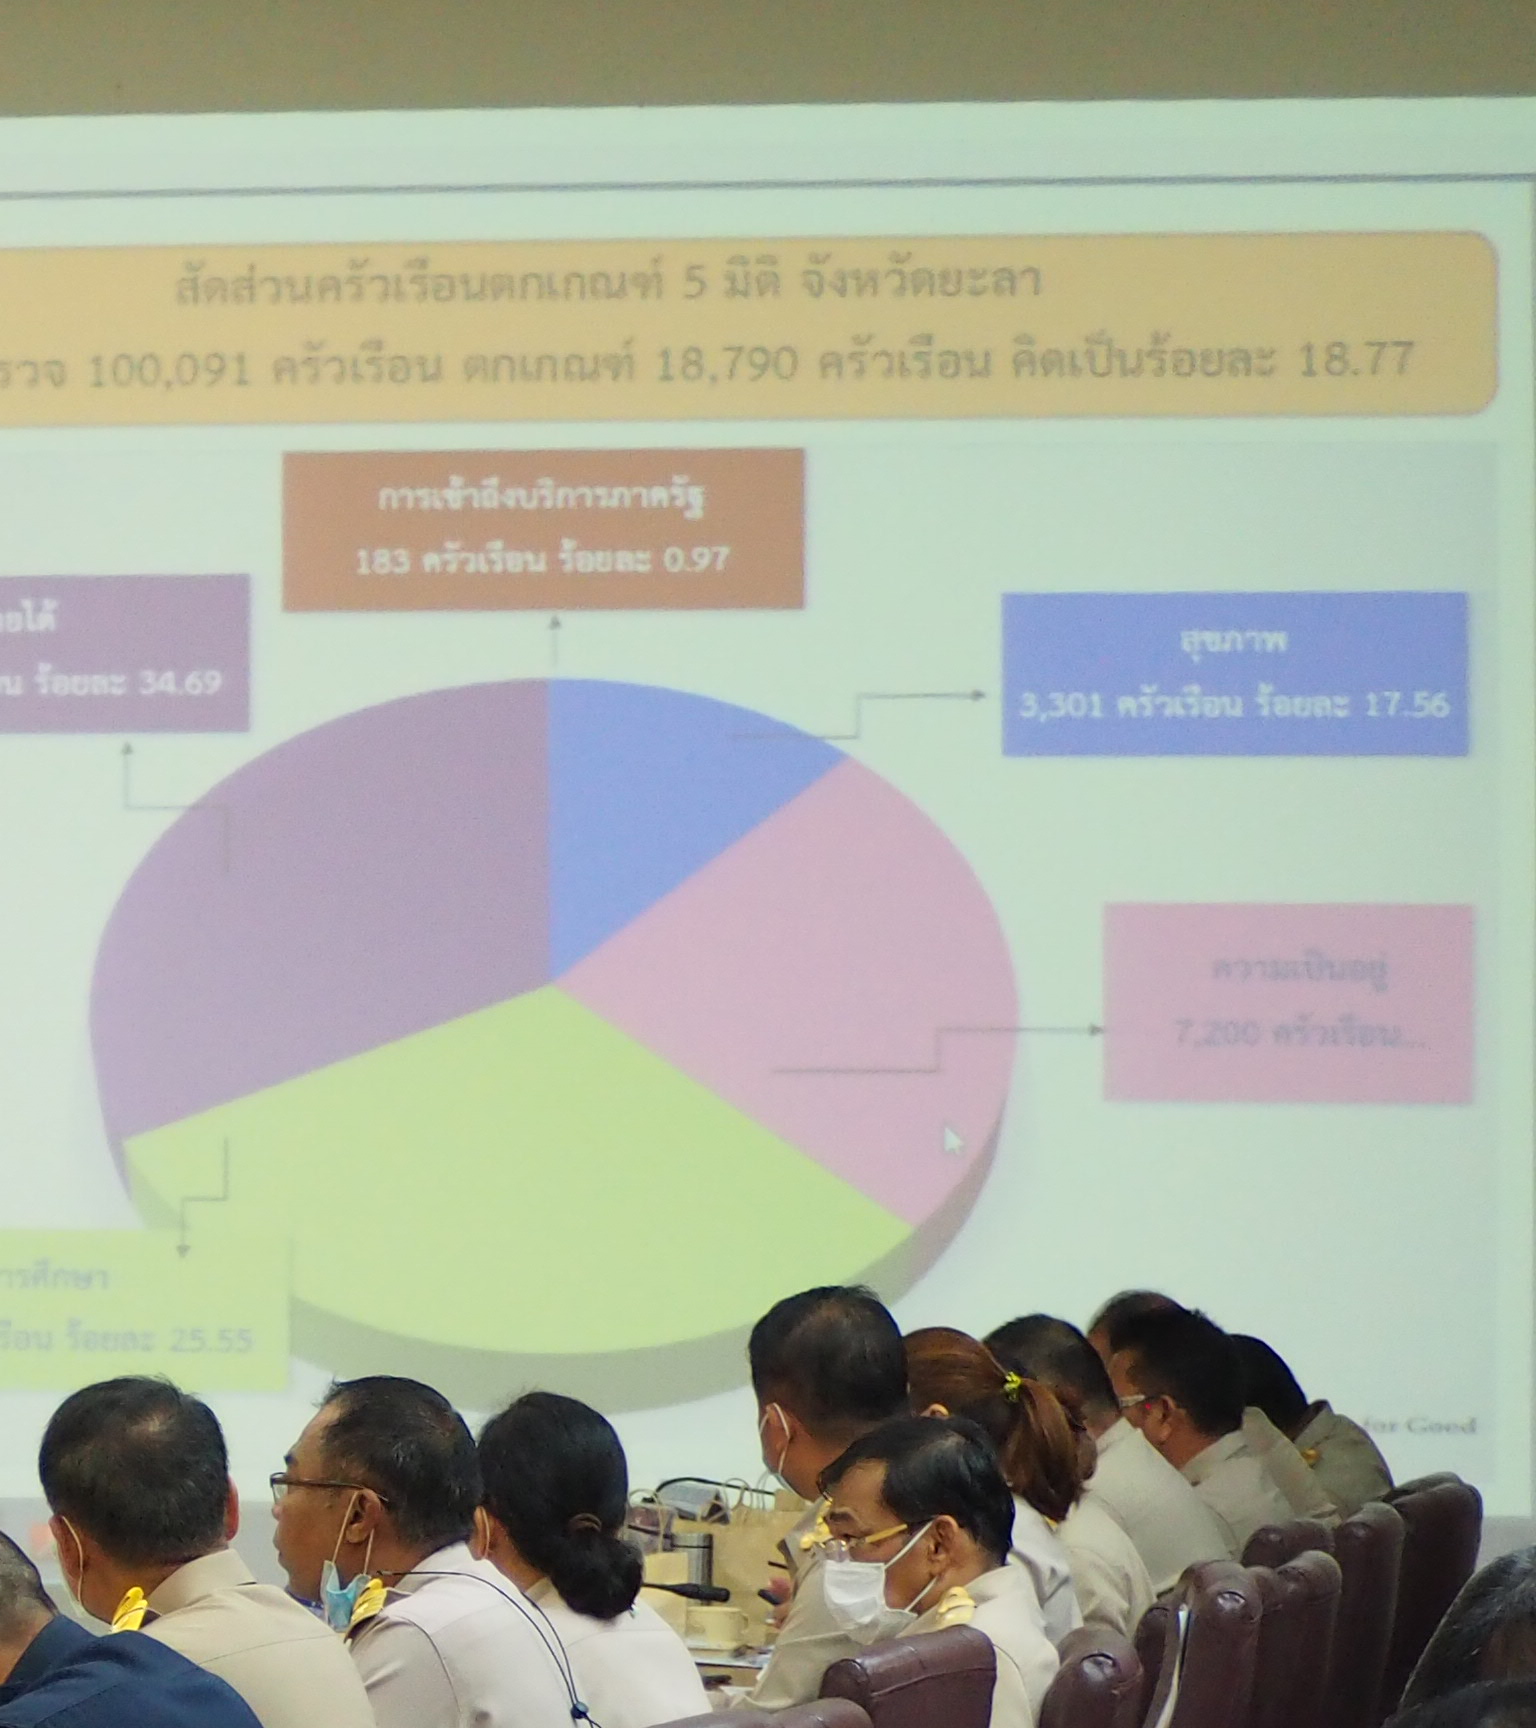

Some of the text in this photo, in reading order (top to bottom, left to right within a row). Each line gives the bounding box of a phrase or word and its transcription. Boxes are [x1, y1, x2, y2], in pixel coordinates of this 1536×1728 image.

[683, 264, 709, 300] 5
[801, 254, 1045, 300] จังหวัดยะลา
[90, 350, 251, 394] 100,091
[274, 337, 443, 387] ครัวเรือน
[657, 345, 800, 391] 18,790
[818, 331, 992, 382] ครัวเรือน
[1011, 329, 1278, 380] คิดเป็นร้อยละ
[1299, 340, 1417, 378] 18.77
[356, 537, 732, 577] 183 ครัวเรือน ร้อยละ 0.97
[138, 669, 224, 697] 34.69
[1019, 691, 1105, 723] 3,301
